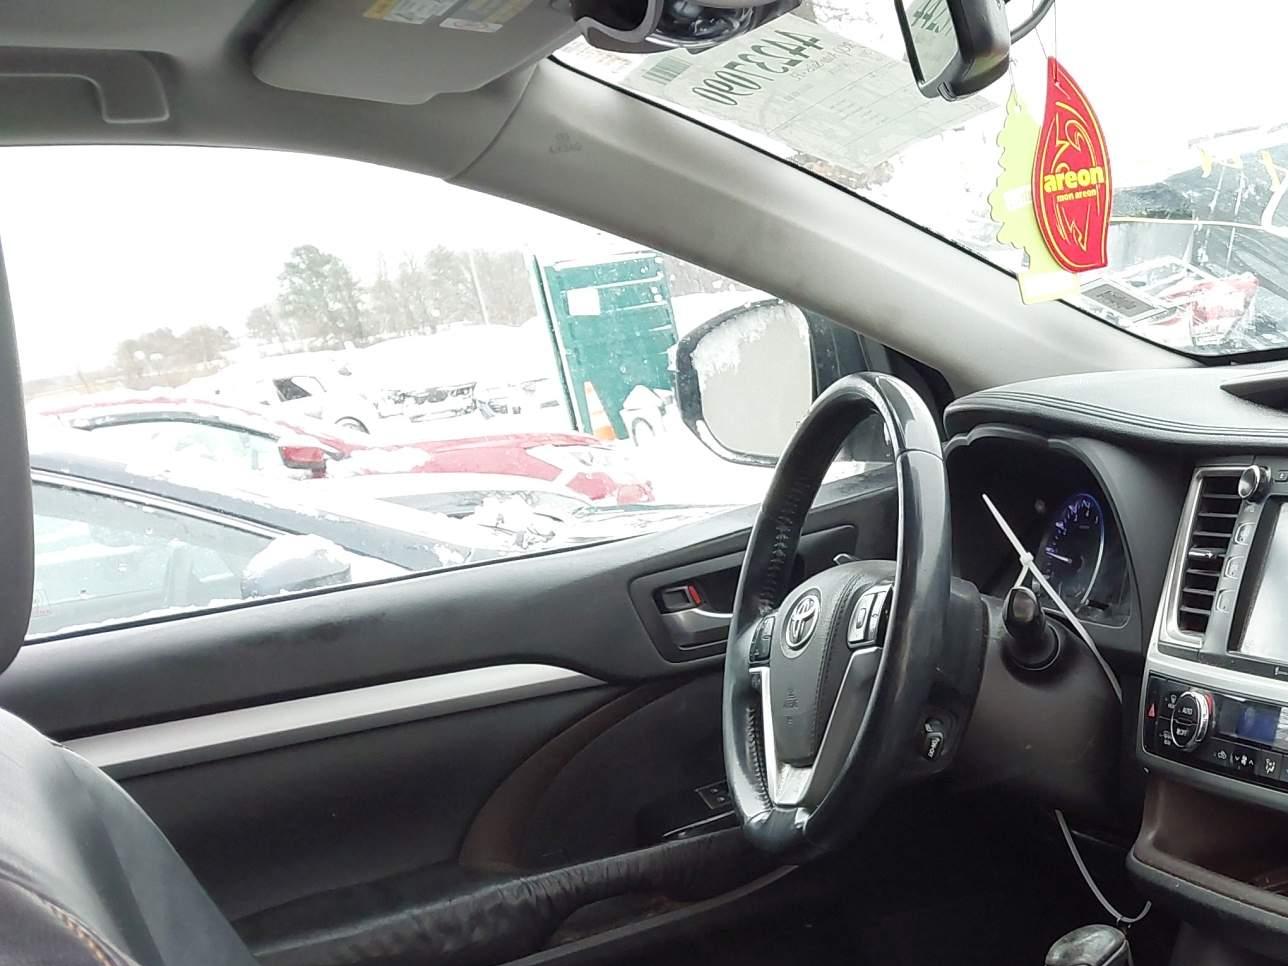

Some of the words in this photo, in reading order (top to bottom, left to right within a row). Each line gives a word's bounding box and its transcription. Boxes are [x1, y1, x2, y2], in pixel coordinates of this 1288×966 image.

[1043, 166, 1104, 193] areon
[1056, 192, 1075, 203] mon
[1075, 189, 1097, 199] areon
